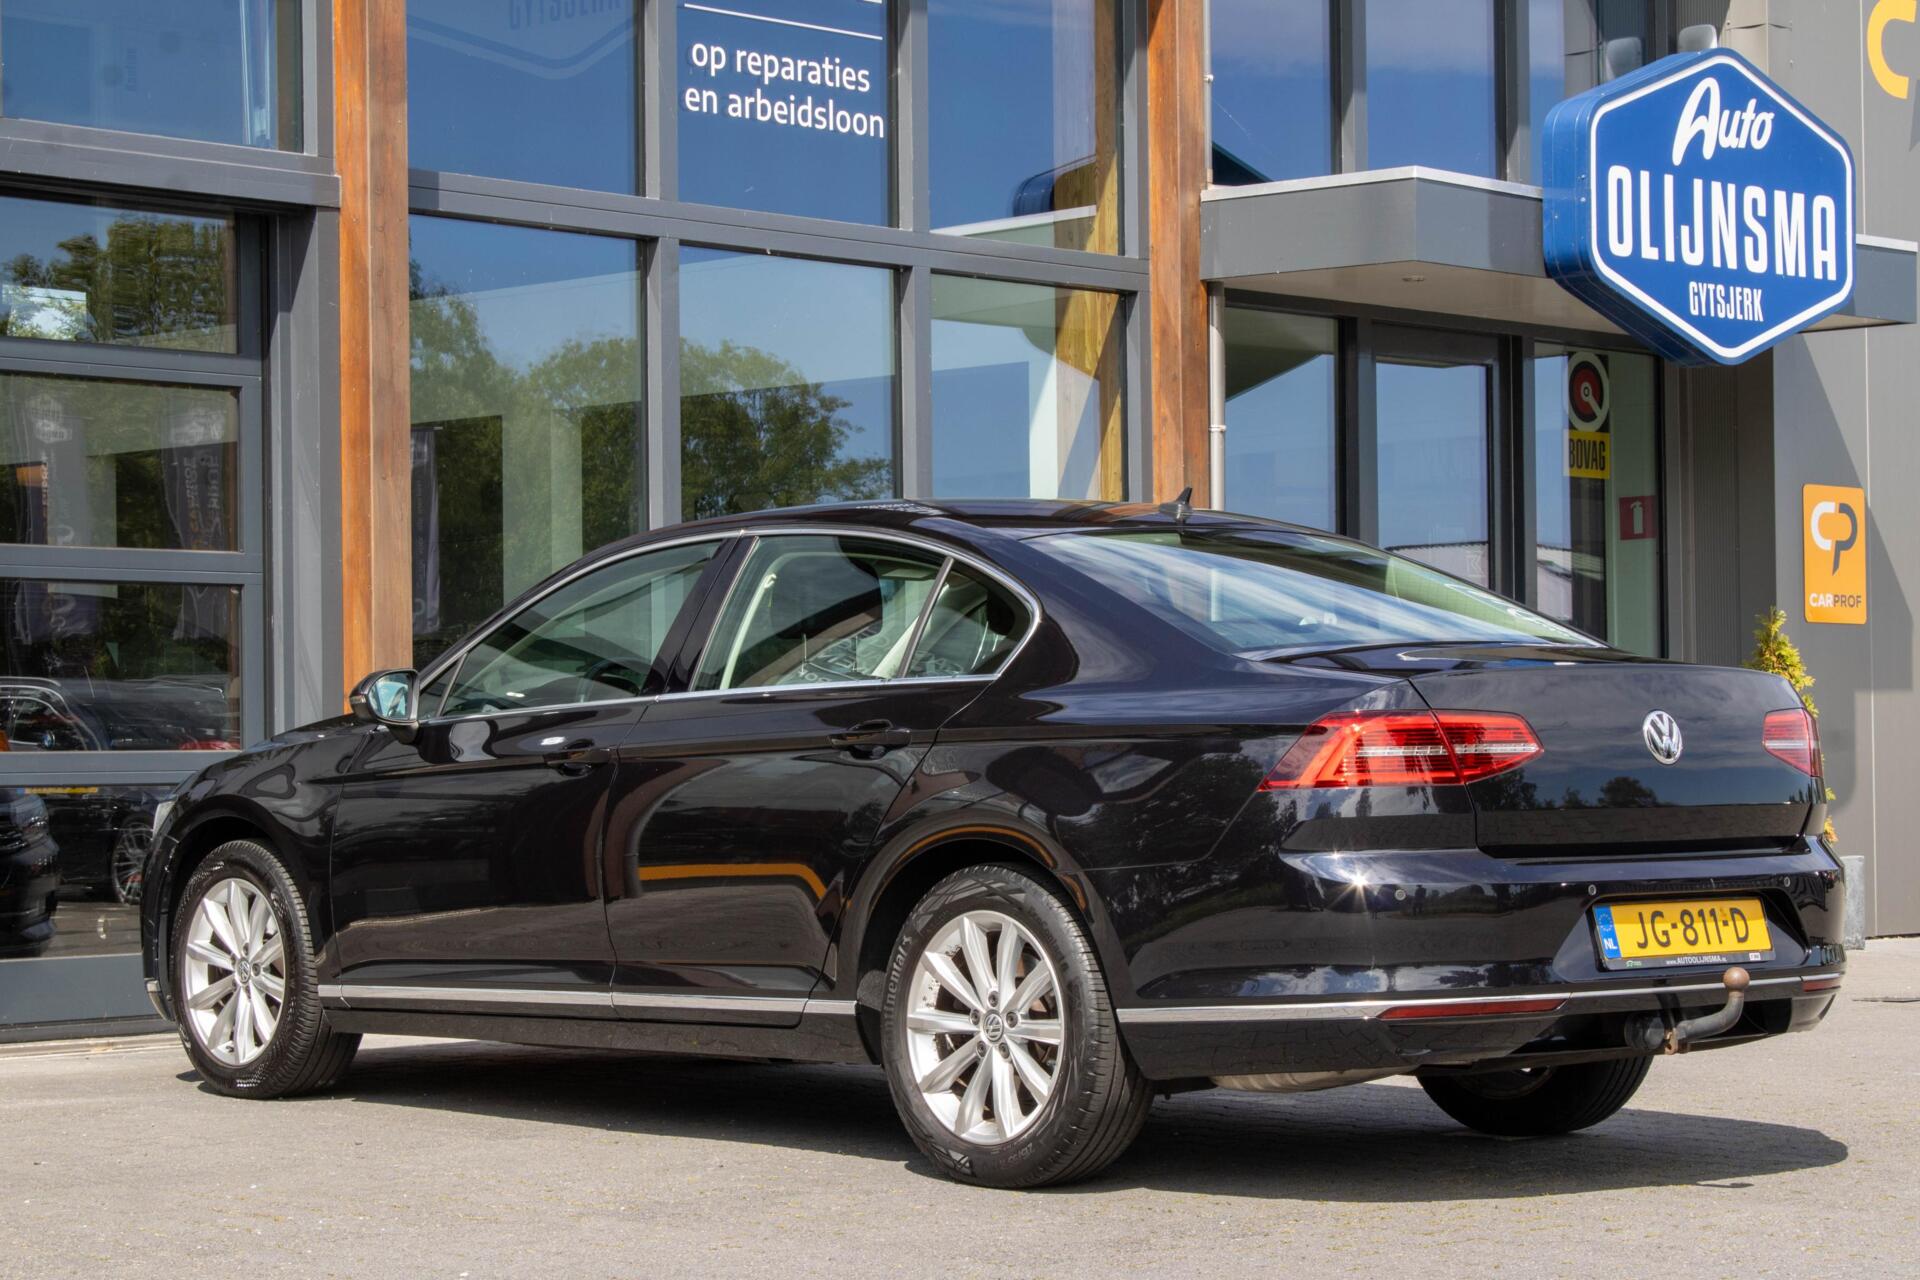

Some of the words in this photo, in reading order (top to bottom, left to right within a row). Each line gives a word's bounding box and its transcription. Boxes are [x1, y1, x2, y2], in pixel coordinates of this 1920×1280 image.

[691, 43, 726, 77] op
[736, 49, 870, 92] reparaties
[685, 87, 718, 114] en
[727, 88, 884, 138] arbeidsloon
[1672, 77, 1775, 166] Auto
[1608, 165, 1837, 281] OLIJNSMA
[1689, 281, 1764, 322] GYTSJERK
[1569, 438, 1606, 471] BOVAG
[1809, 593, 1862, 608] CARPROF
[1604, 938, 1618, 950] NL
[1637, 907, 1750, 949] JG-811-D
